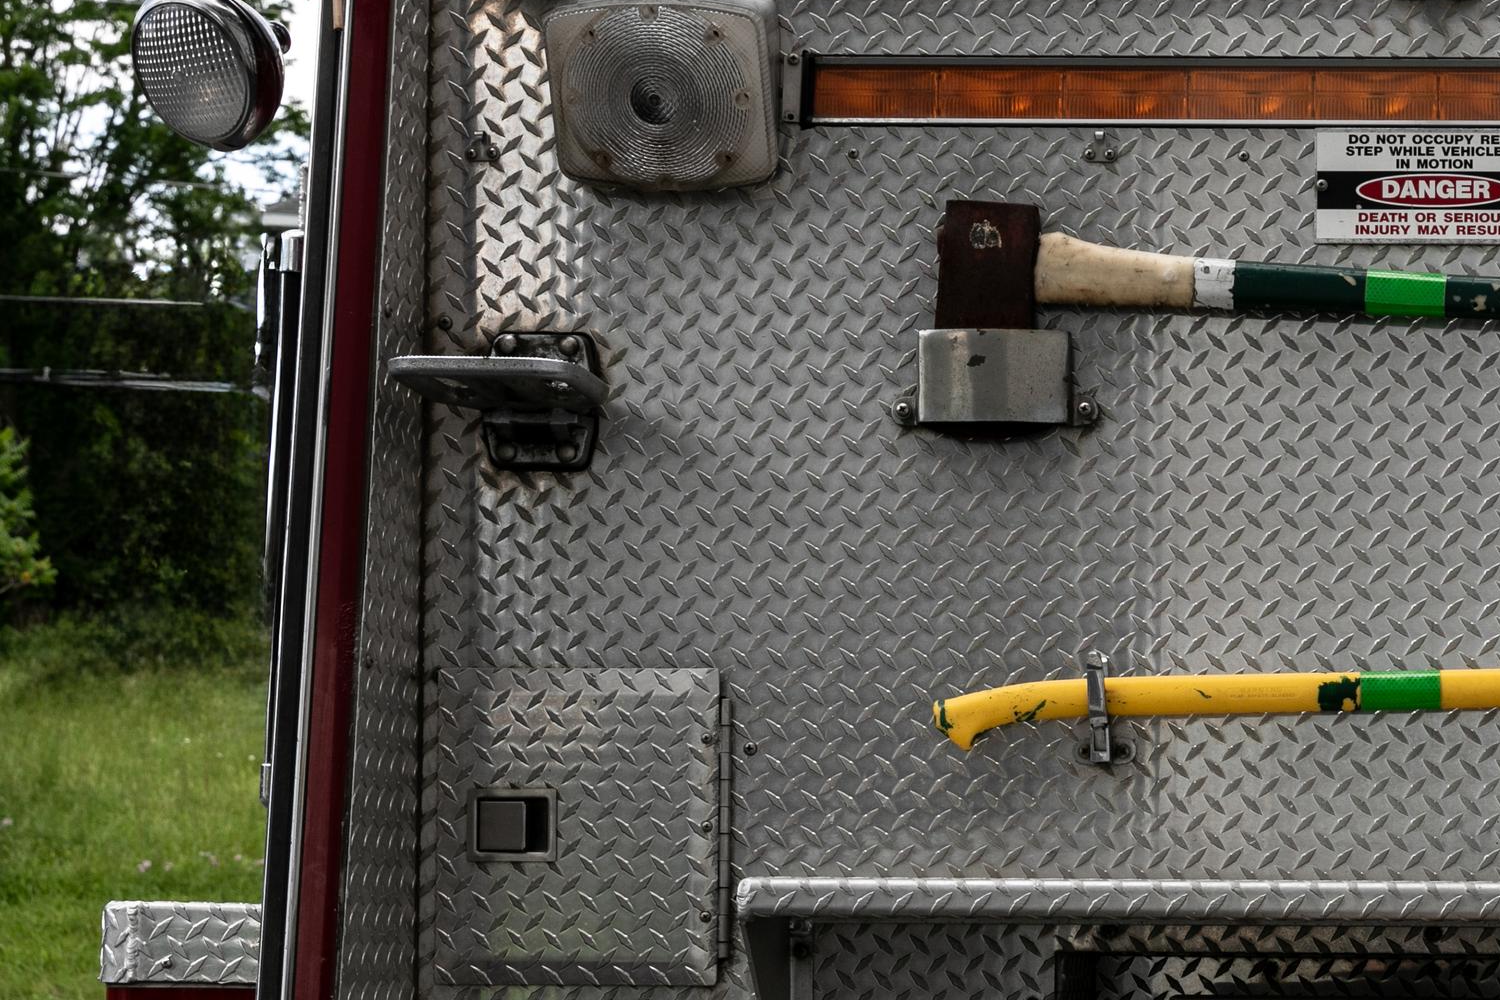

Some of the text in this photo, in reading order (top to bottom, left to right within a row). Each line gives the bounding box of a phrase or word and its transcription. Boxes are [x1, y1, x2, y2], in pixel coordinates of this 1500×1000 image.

[1348, 134, 1370, 145] DO
[1376, 134, 1406, 145] NOT
[1412, 134, 1474, 145] OCCUPY
[1345, 146, 1383, 157] STEP
[1389, 146, 1435, 157] WHILE
[1396, 159, 1473, 170] IN MOTION
[1381, 180, 1491, 199] DANGER
[1358, 213, 1408, 223] DEATH
[1415, 212, 1437, 223] OR
[1355, 225, 1410, 235] INJURY
[1417, 225, 1448, 236] MAY
